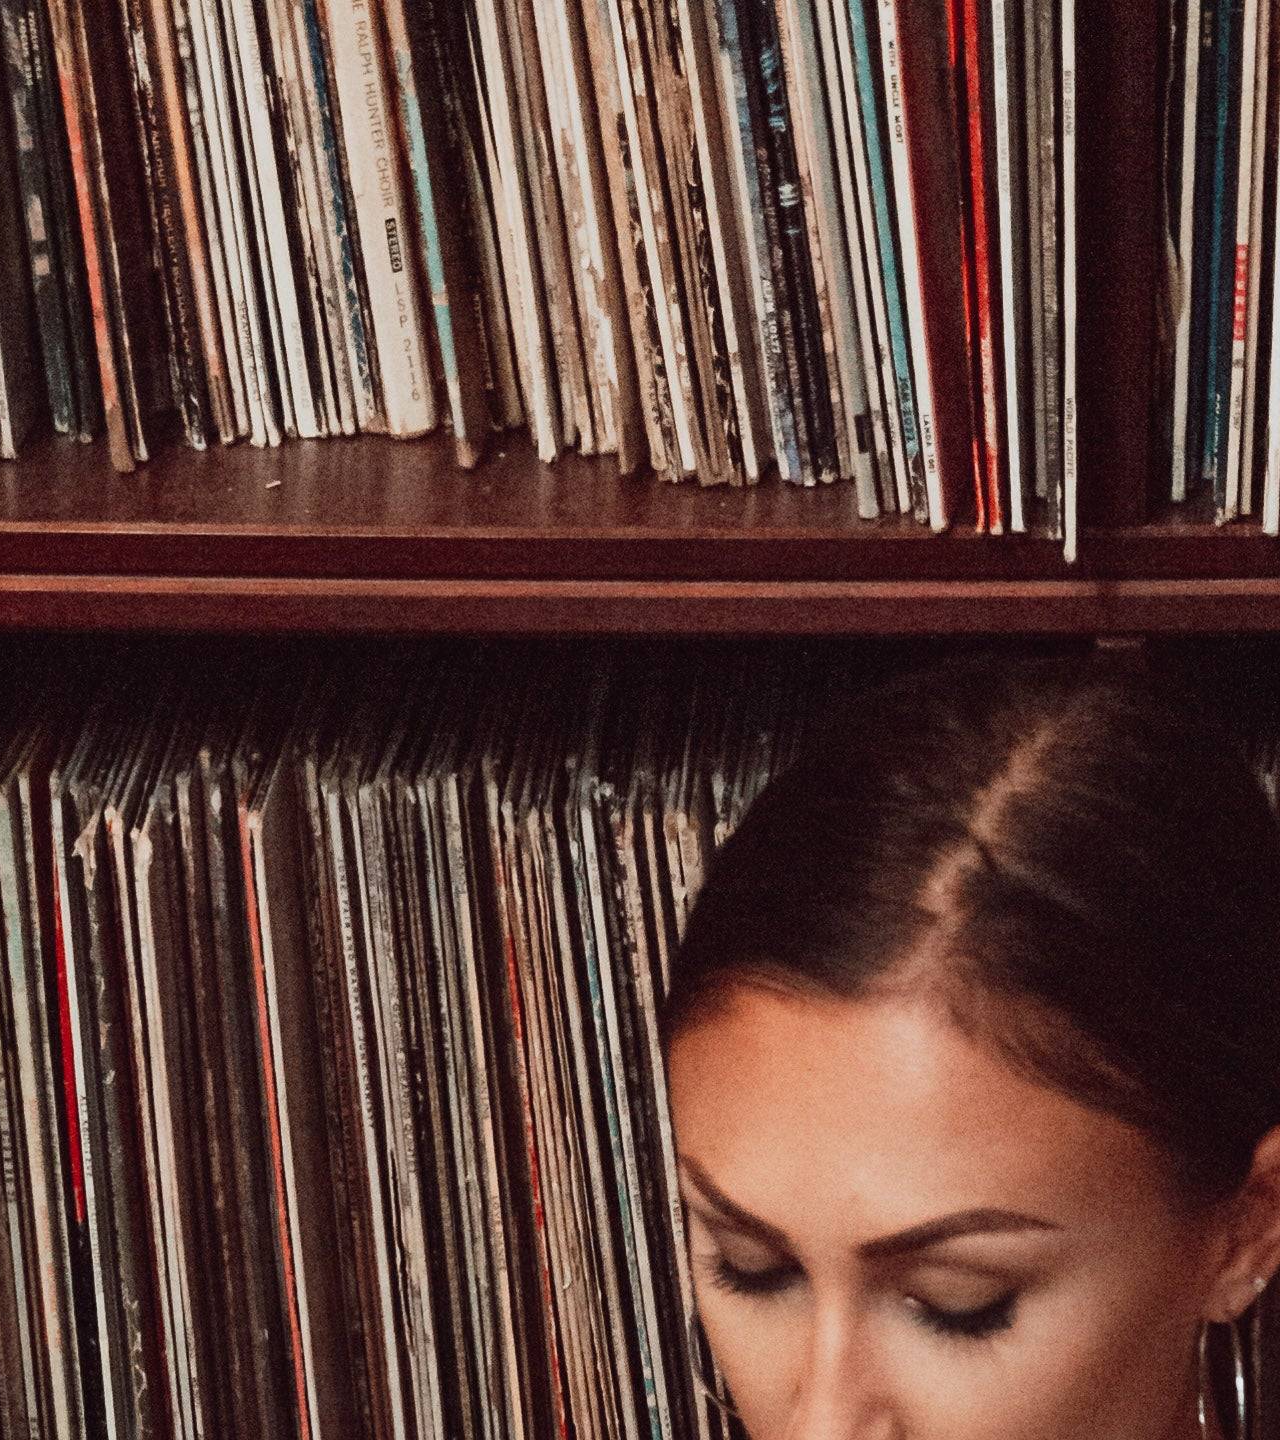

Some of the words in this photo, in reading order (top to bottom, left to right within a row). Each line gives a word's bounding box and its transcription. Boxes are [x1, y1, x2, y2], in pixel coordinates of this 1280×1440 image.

[887, 40, 896, 67] WITH
[890, 74, 899, 107] UNCLE
[1063, 69, 1072, 94] BUD
[1064, 98, 1073, 136] SHANK
[353, 20, 373, 74] RALPH
[363, 82, 385, 149] HUNTER
[375, 156, 394, 207] CHOIR
[385, 219, 402, 272] STEREO
[403, 337, 420, 401] 2116
[1064, 397, 1073, 433] WORLD
[1065, 438, 1074, 477] PACIFIC
